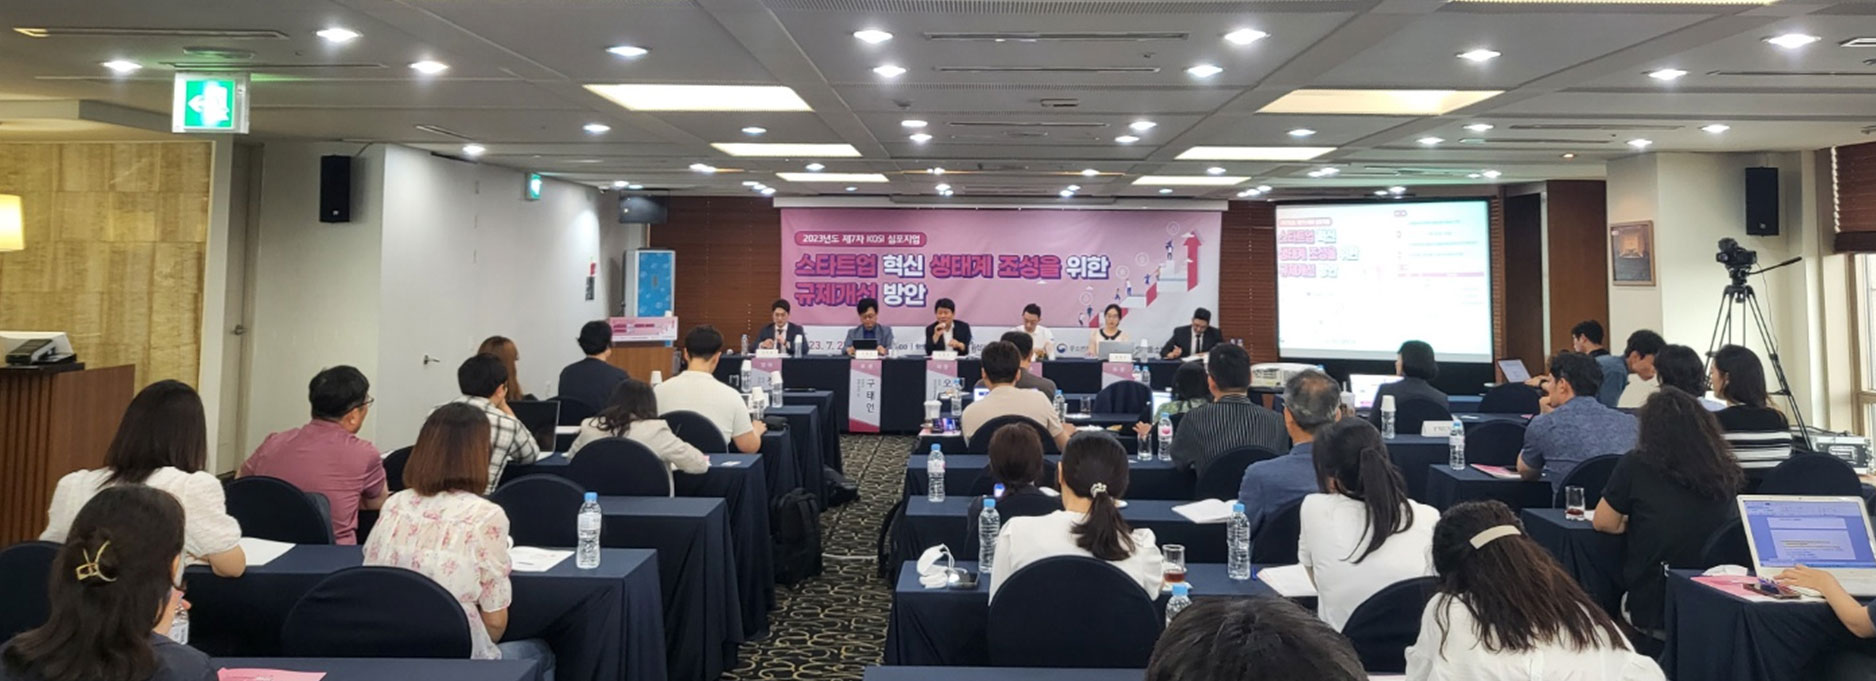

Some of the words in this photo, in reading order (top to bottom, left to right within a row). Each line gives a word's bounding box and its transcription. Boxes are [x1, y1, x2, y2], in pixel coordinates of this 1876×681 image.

[803, 234, 839, 244] 2023년도
[842, 235, 865, 245] 제7차
[794, 253, 878, 278] 스타트업
[882, 253, 925, 278] 혁신
[929, 253, 993, 279] 생태계
[997, 254, 1062, 279] 조성을
[1065, 254, 1111, 280] 위한
[794, 281, 878, 307] 규제개선
[882, 282, 928, 307] 방안
